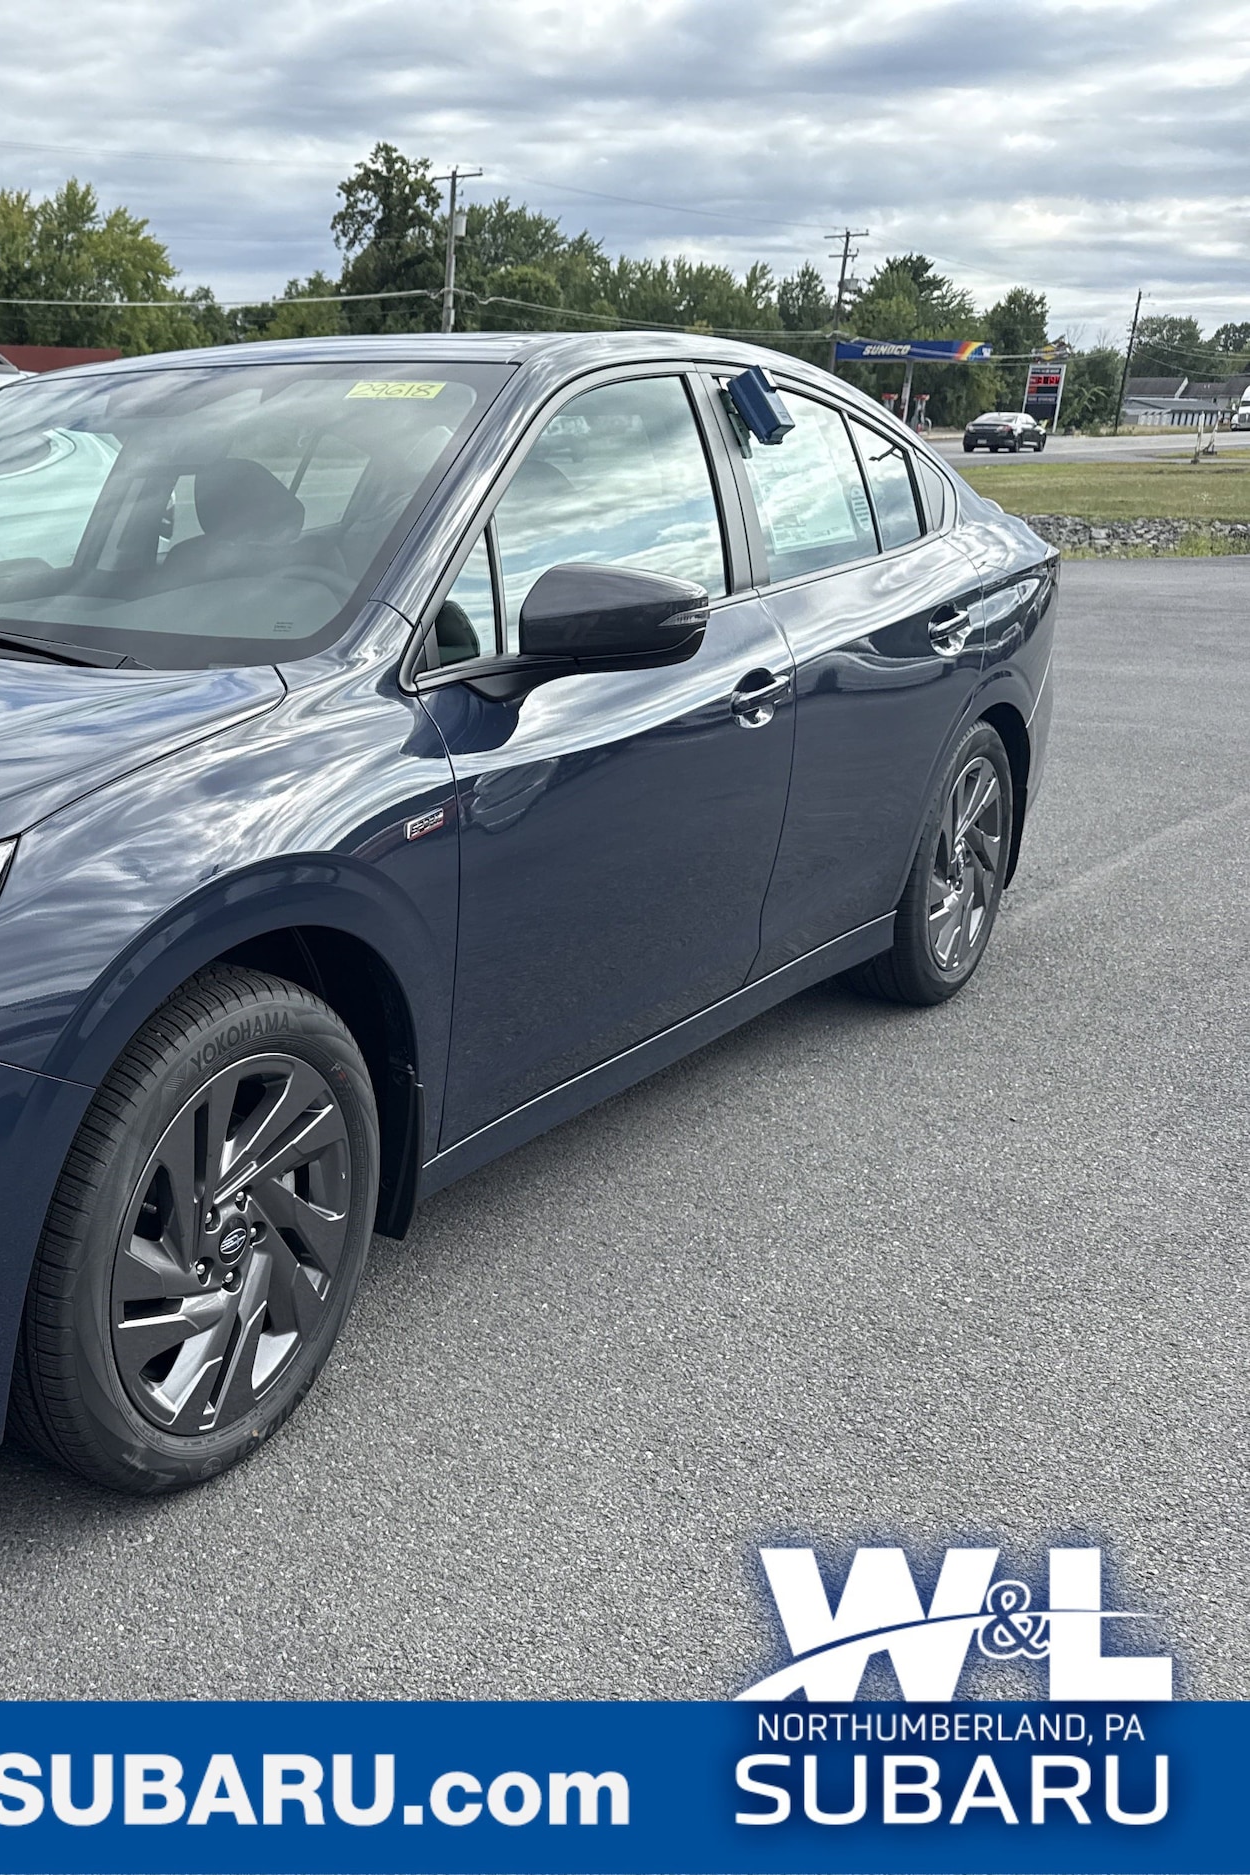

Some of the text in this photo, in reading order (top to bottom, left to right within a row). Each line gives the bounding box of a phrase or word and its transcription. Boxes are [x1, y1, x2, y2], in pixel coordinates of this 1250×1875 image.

[862, 345, 911, 356] SUNOCO
[351, 383, 436, 397] 29618
[190, 1011, 291, 1072] YOKOHAMA
